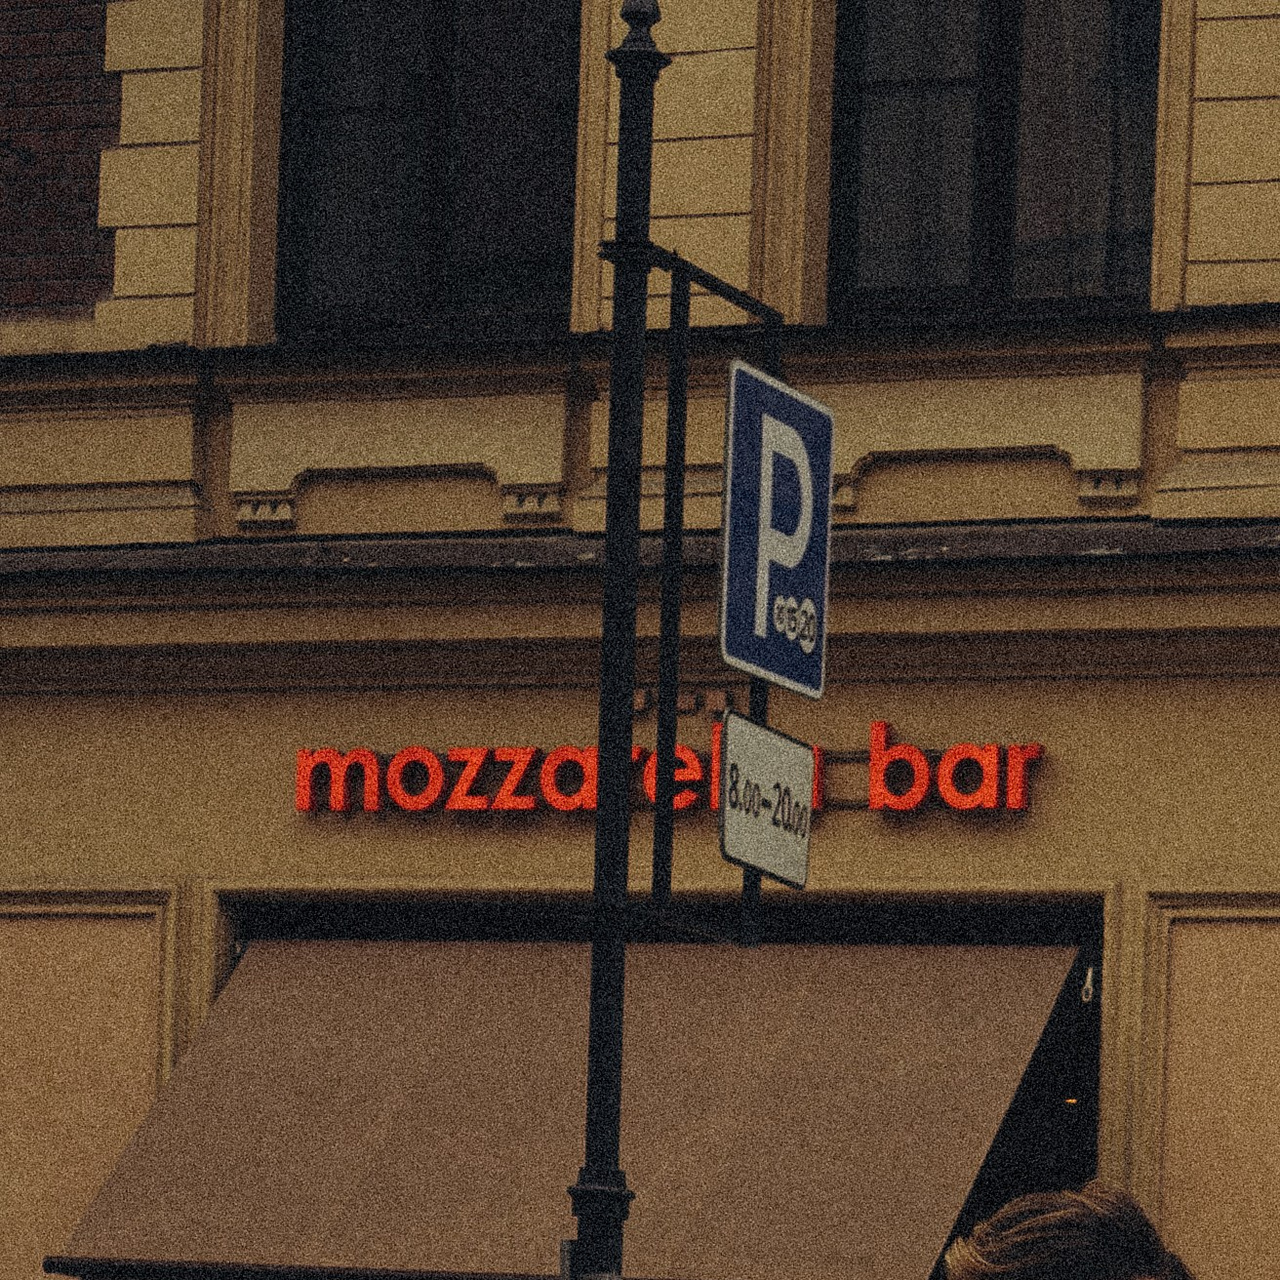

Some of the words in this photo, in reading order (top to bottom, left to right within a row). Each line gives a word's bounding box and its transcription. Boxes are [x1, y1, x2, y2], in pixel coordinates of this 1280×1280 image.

[755, 412, 815, 639] P
[295, 722, 822, 812] mozzael
[869, 720, 1043, 811] bar
